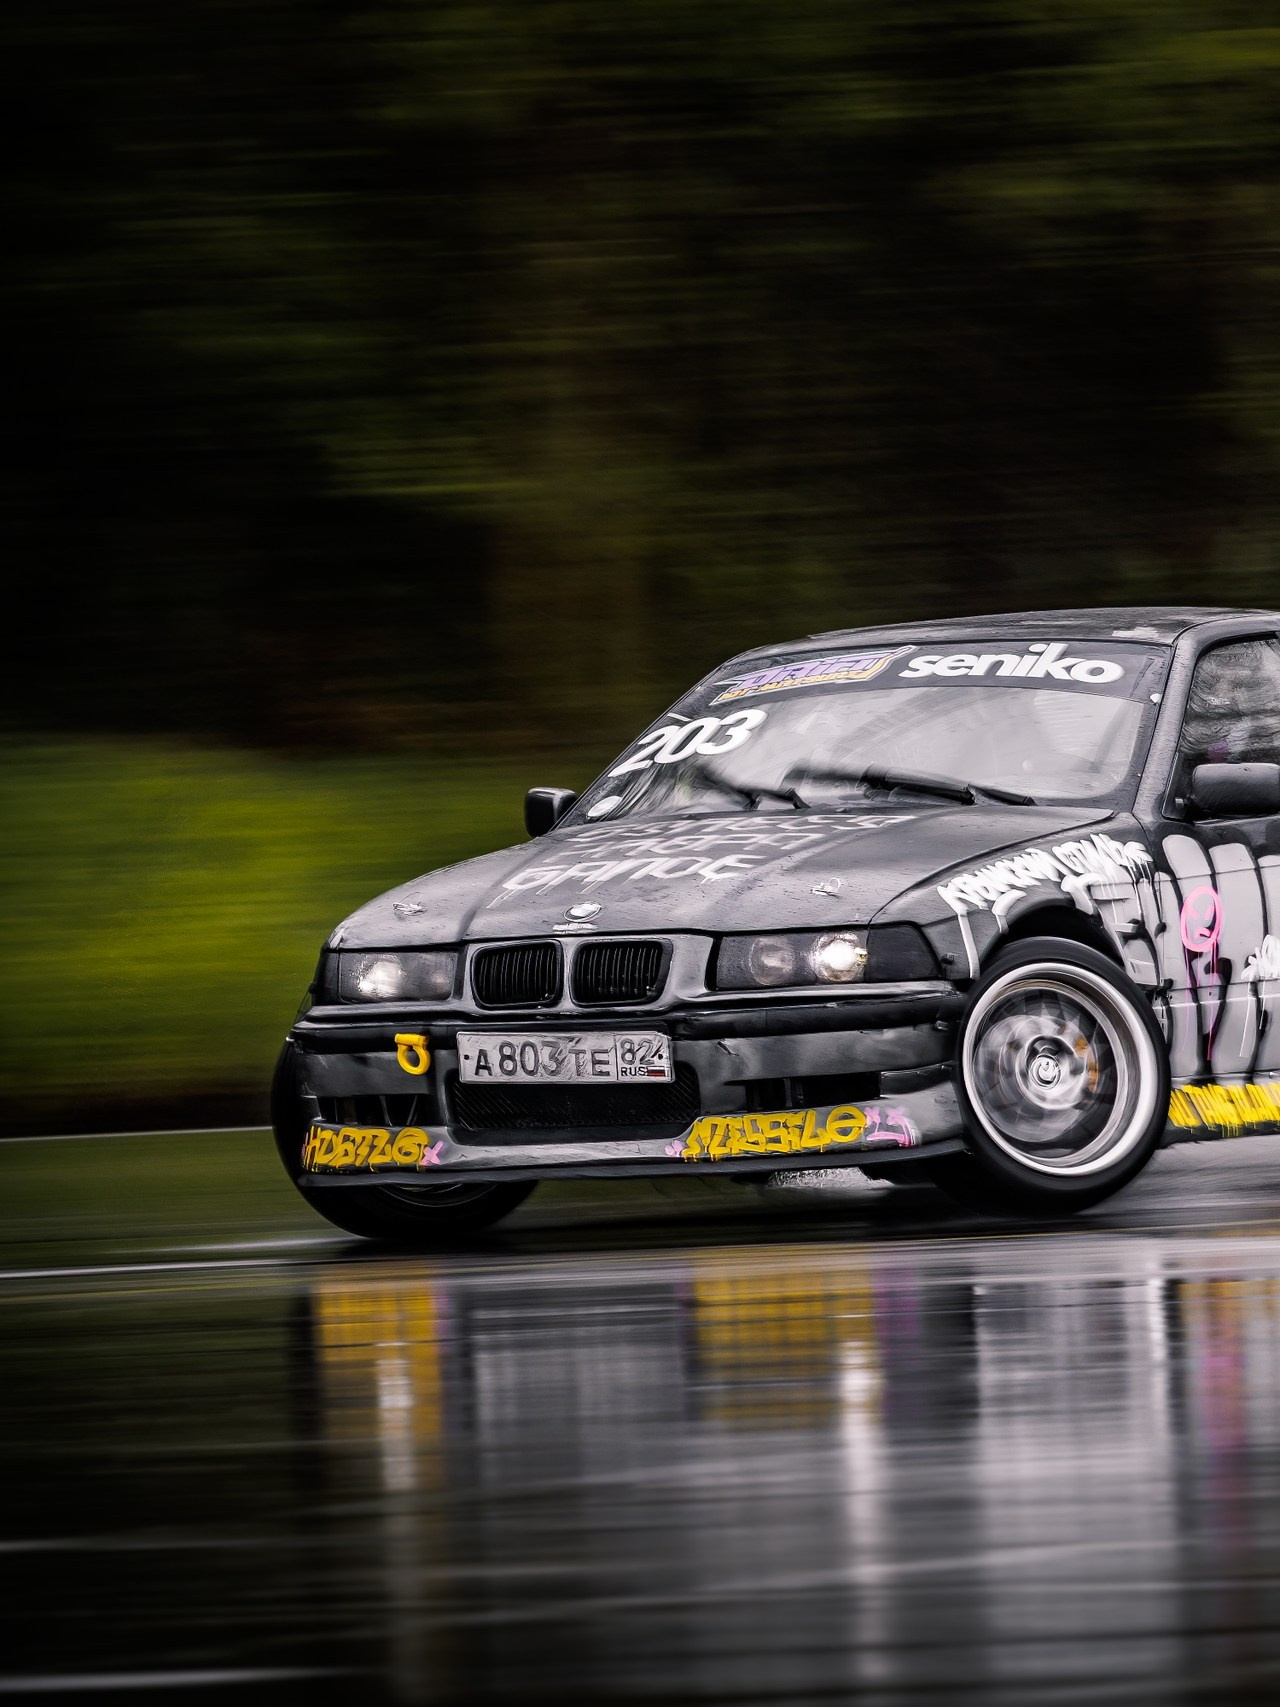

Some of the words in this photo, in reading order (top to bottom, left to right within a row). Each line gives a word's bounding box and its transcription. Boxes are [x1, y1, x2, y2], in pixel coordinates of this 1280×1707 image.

[898, 643, 1126, 684] seniko
[607, 709, 768, 778] 203
[620, 1038, 655, 1065] 82
[621, 1066, 647, 1077] RUS
